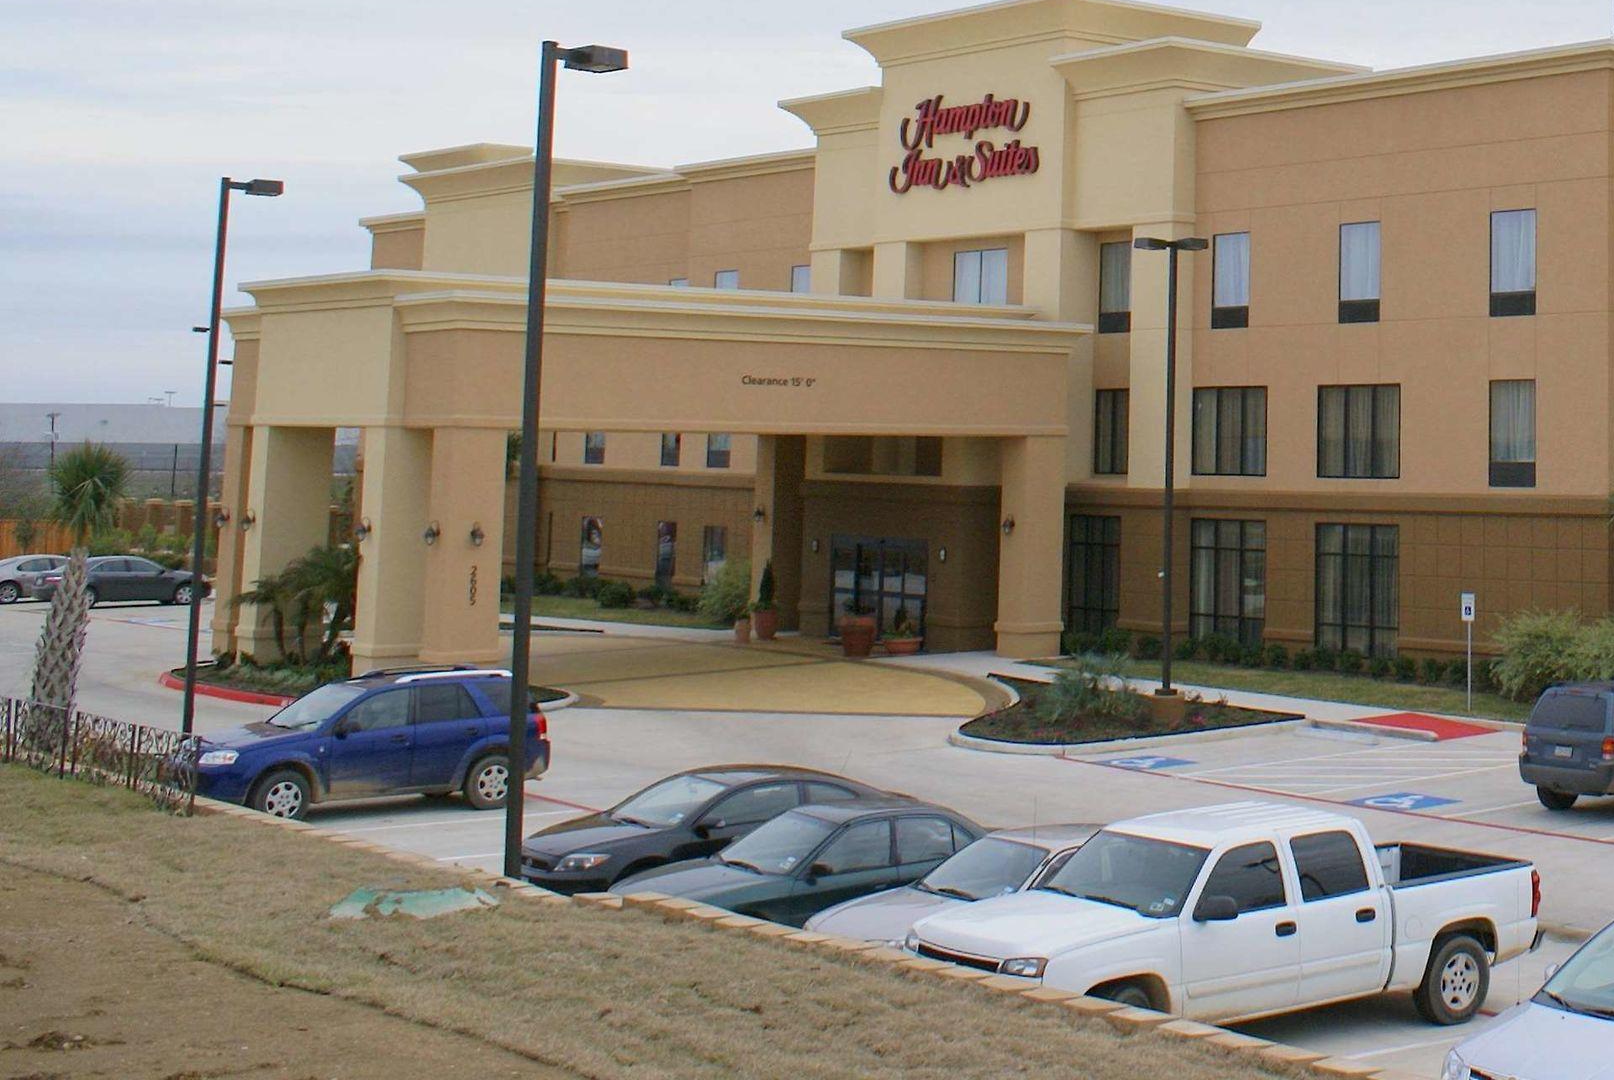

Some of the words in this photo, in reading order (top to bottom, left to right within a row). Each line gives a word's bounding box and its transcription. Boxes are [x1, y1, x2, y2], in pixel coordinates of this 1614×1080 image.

[900, 93, 1030, 151] Hampton
[889, 148, 951, 194] Inn
[967, 139, 1040, 182] Suites
[741, 374, 789, 387] Clearance
[469, 564, 478, 607] 2605
